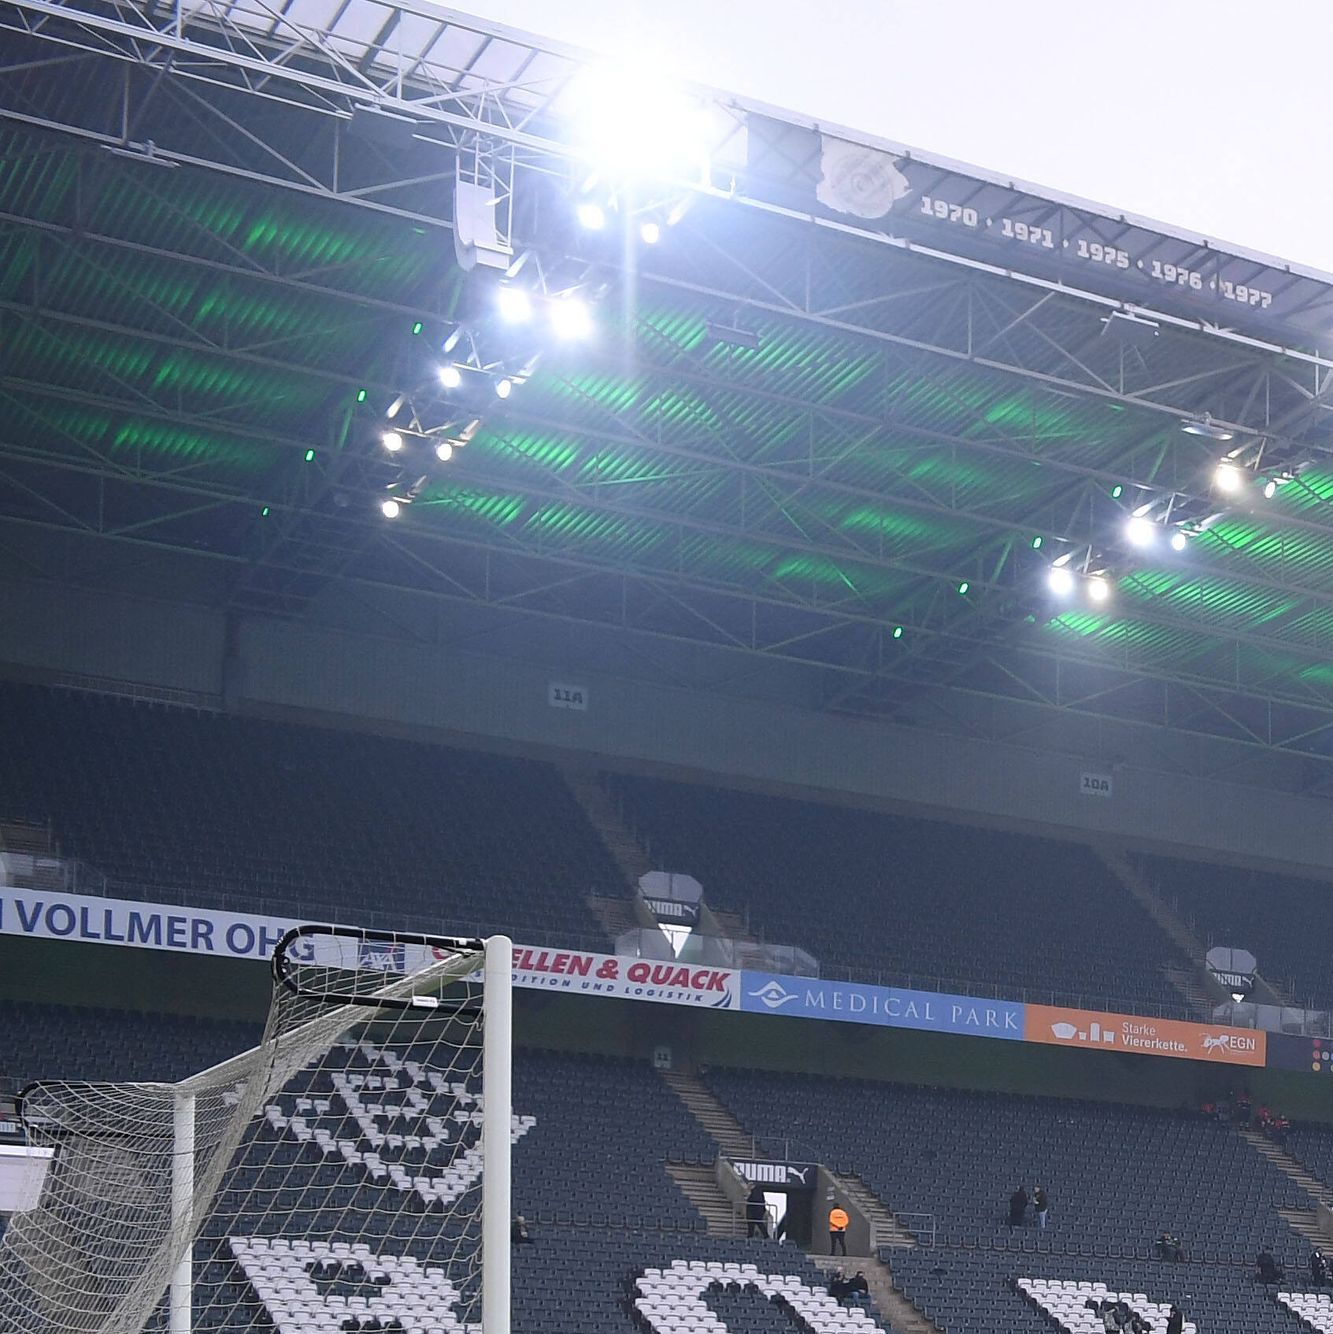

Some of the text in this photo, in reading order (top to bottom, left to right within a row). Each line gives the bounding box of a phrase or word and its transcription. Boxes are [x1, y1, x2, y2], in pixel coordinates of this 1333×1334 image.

[921, 196, 1272, 309] 1970 1971 1975 1976 1977
[14, 899, 214, 951] VOLLMER
[595, 959, 619, 979] &
[627, 963, 731, 992] QUACK
[624, 987, 704, 1002] LOGISTIK
[804, 989, 1018, 1030] MEDICAL PARK
[1121, 1021, 1156, 1037] Starke
[1121, 1033, 1188, 1053] Viererkette.
[1229, 1036, 1256, 1051] EGN
